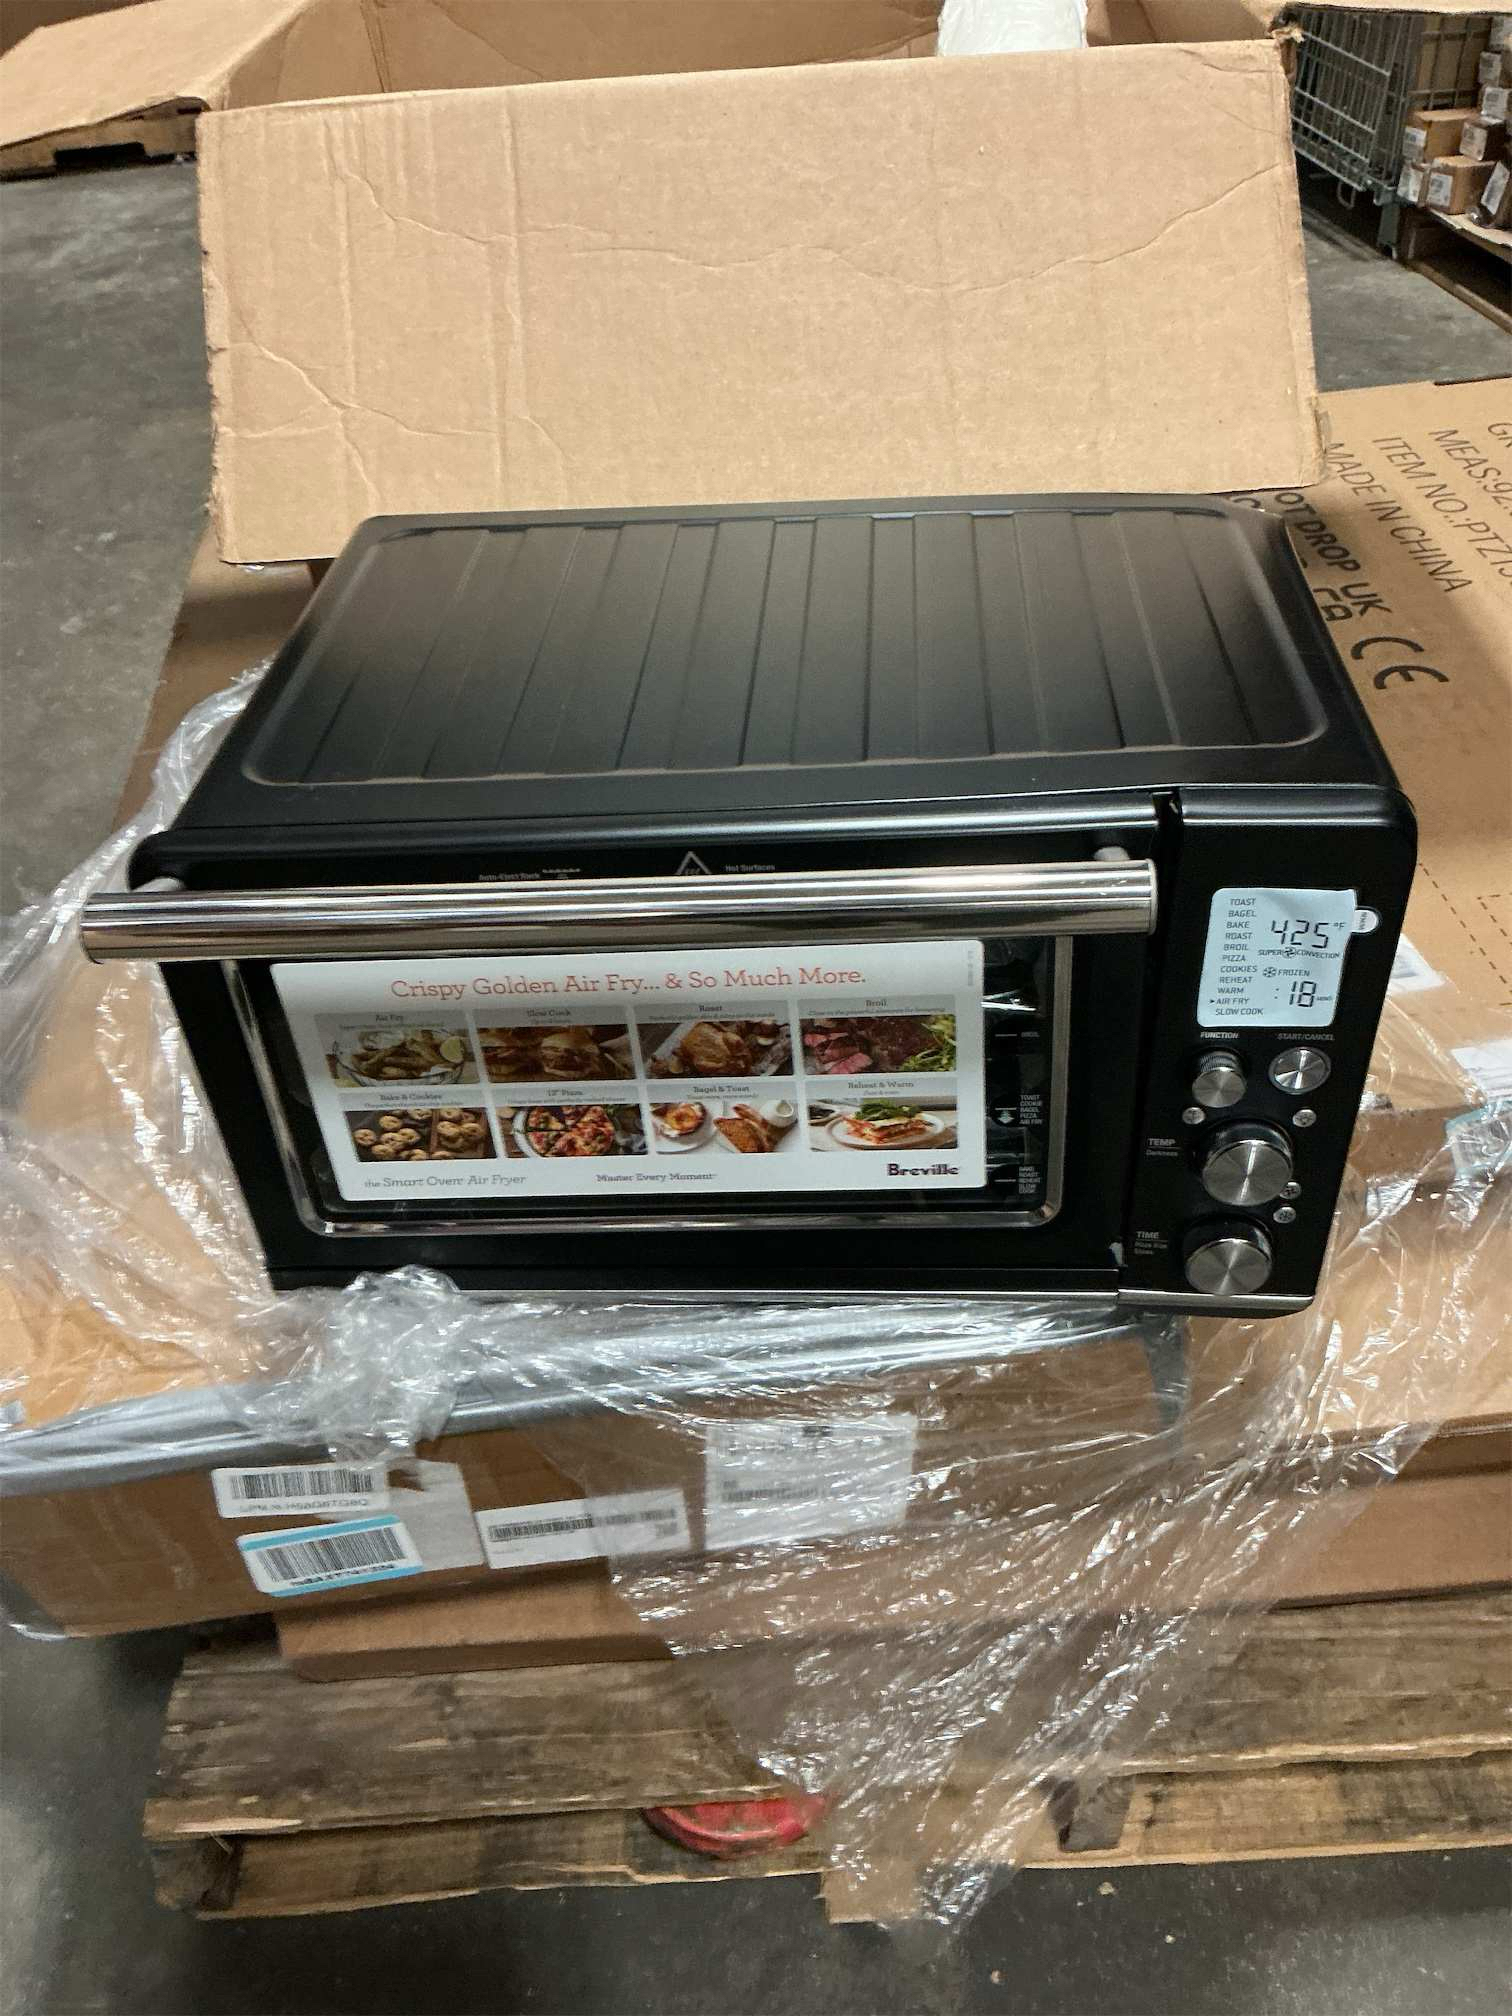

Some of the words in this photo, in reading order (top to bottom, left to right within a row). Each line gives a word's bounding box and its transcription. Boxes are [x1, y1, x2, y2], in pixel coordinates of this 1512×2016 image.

[1371, 437, 1437, 480] ITEM
[1275, 492, 1317, 515] OT
[1328, 442, 1387, 497] MADE
[1364, 500, 1411, 522] IN
[1389, 526, 1473, 593] CHINA
[1295, 520, 1361, 571] DROP
[1340, 582, 1393, 616] UK
[1230, 898, 1256, 906] TOAST
[1226, 921, 1250, 929] BAKE
[1225, 932, 1253, 940] ROAST
[1271, 919, 1329, 949] 425
[1295, 949, 1340, 959] CONVECTION
[1278, 969, 1310, 977] FROZEN
[391, 978, 466, 1000] Crispy
[472, 975, 557, 995] Golden
[565, 975, 600, 993] Air
[606, 973, 661, 995] Fry...
[664, 973, 683, 989] &
[688, 971, 717, 989] So
[724, 966, 793, 987] Much
[798, 967, 867, 985] More.
[1215, 1008, 1239, 1016] SLOW
[1200, 1031, 1239, 1039] FUNCTION
[1277, 1033, 1334, 1042] START/CANCEL
[1147, 1138, 1176, 1146] TEMP
[887, 1163, 960, 1177] Breville
[383, 1177, 425, 1188] Smart
[467, 1175, 489, 1185] Air
[491, 1174, 527, 1186] Fryer
[636, 1172, 667, 1182] Every
[1136, 1231, 1160, 1239] TIME
